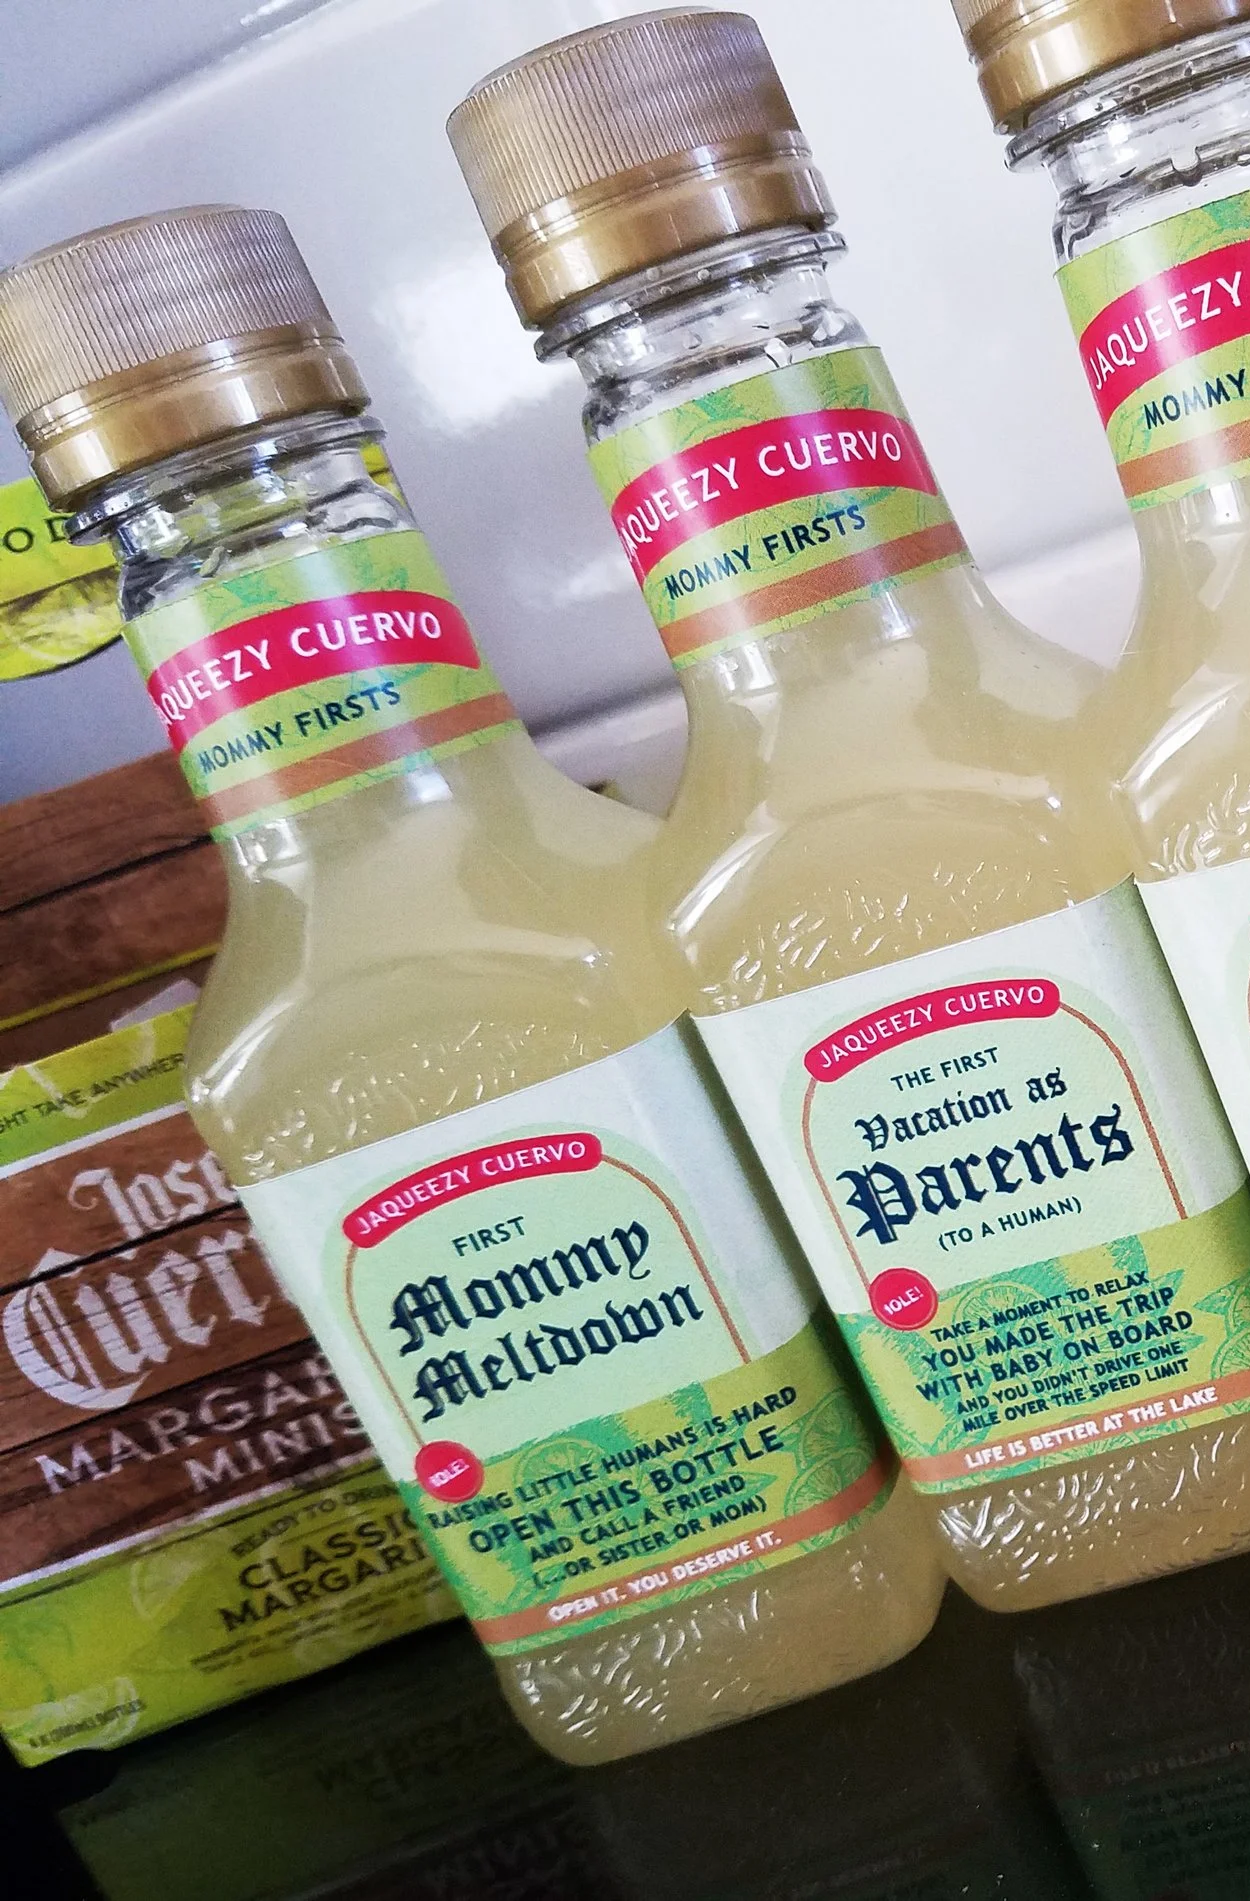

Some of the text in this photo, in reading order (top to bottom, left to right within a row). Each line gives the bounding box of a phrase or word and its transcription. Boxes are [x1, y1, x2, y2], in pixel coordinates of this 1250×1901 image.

[1089, 271, 1242, 390] JAQUEEZY
[1144, 369, 1246, 430] MOMMY
[758, 430, 901, 476] CUERVO
[665, 505, 865, 600] MOMMY FIRSTS
[290, 611, 441, 657] CUERVO
[199, 681, 400, 776] MOMMY FIRSTS
[818, 986, 1044, 1069] JAQUEEZY CUERVO
[890, 1047, 998, 1091] THE FIRST
[33, 1090, 87, 1117] TAKE
[90, 1053, 185, 1098] ANYWHER
[854, 1067, 1068, 1151] Vacation as
[357, 1141, 586, 1235] JAQUEEZY CUERVO
[836, 1103, 1136, 1244] Parents
[452, 1216, 526, 1257] FIRST
[939, 1196, 1082, 1251] (TO A HUMAN)
[389, 1220, 651, 1357] Mommy
[921, 1287, 1175, 1371] YOU MADE THE TRIP
[930, 1271, 1149, 1343] TAKE A MOMENT TO RELAX
[413, 1284, 704, 1423] Meltdown
[916, 1310, 1193, 1402] WITH BABY ON BOARD
[957, 1341, 1183, 1415] AND YOU DIDN'T DRIVE ONE
[963, 1359, 1189, 1433] MILE OVER THE SPEED LIMIT
[963, 1386, 1218, 1469] LIFE IS BETTER AT THE LAKE
[427, 1386, 797, 1529] RAISING LITTLE HUMANS IS HARD
[468, 1425, 785, 1553] OPEN THIS BOTTLE
[530, 1475, 746, 1563] AND CALL A FRIEND
[599, 1531, 668, 1565] SISTER
[675, 1519, 705, 1539] OR
[709, 1495, 768, 1529] MOM)
[219, 1537, 427, 1632] MARGARI
[548, 1597, 599, 1622] OPEN
[627, 1572, 669, 1595] YOU
[672, 1540, 752, 1582] DESERVE
[754, 1531, 783, 1550] IT.
